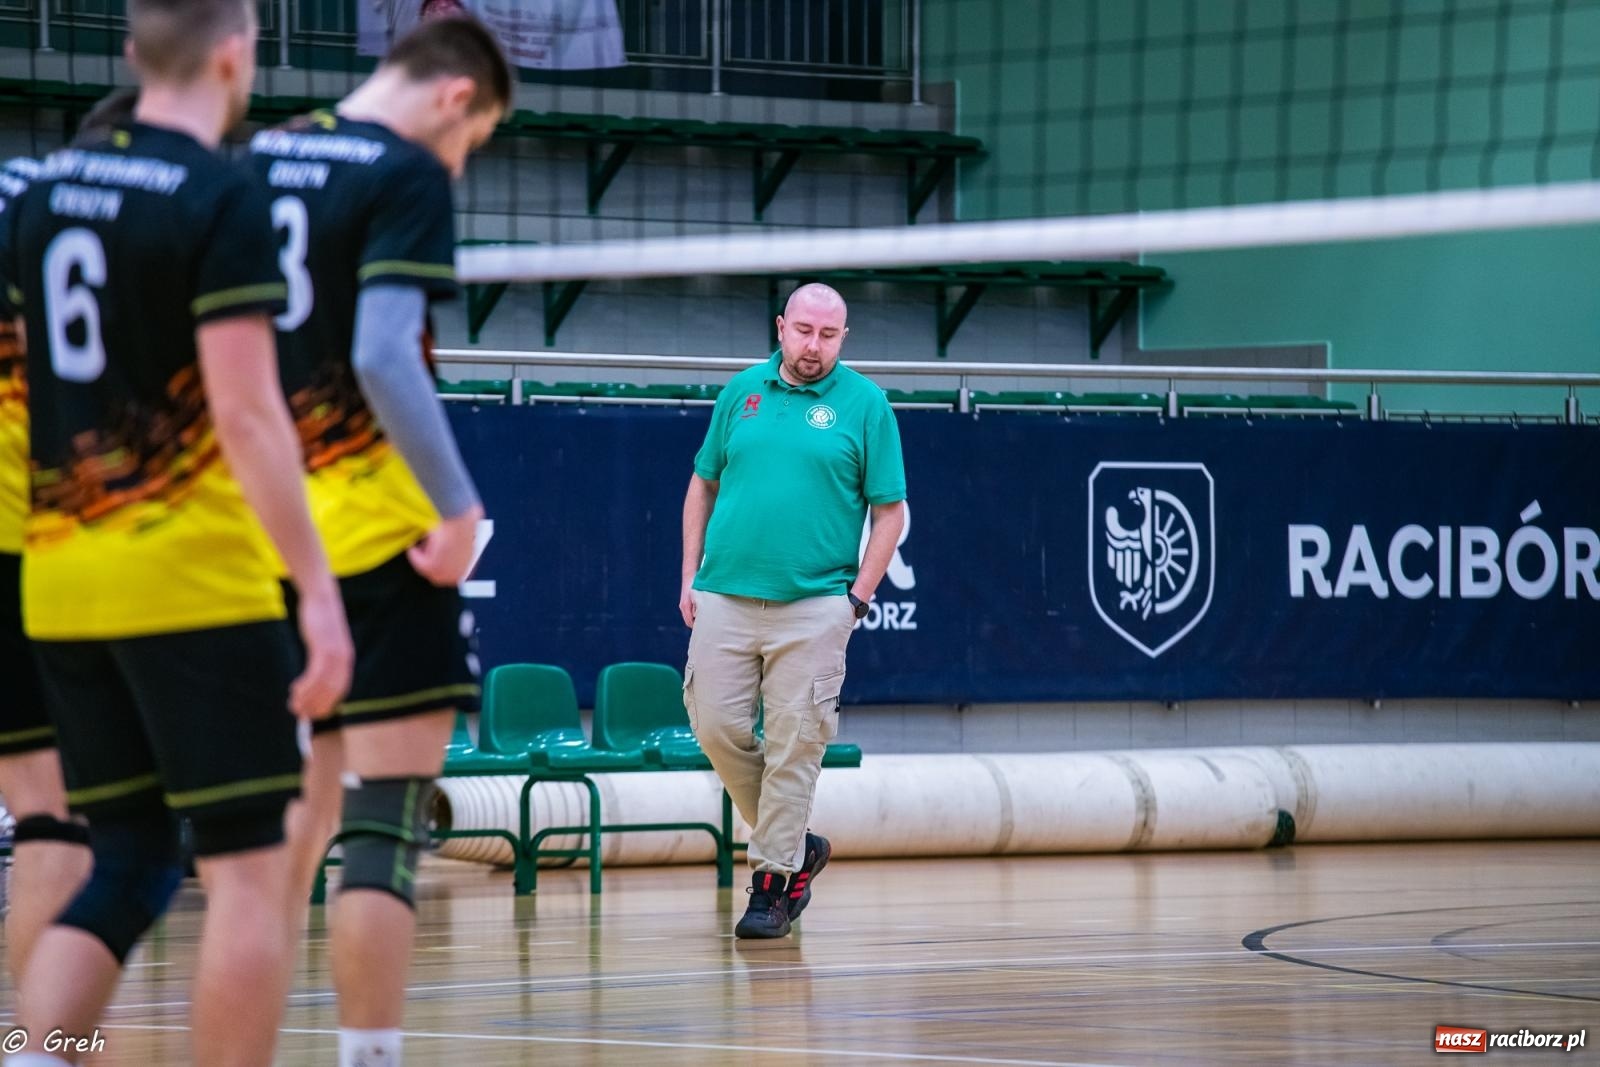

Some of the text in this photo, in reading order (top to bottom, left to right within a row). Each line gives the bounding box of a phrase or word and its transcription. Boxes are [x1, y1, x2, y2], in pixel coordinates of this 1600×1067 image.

[43, 227, 107, 383] 6
[271, 196, 314, 332] 3
[1288, 499, 1600, 600] RACIBÓR
